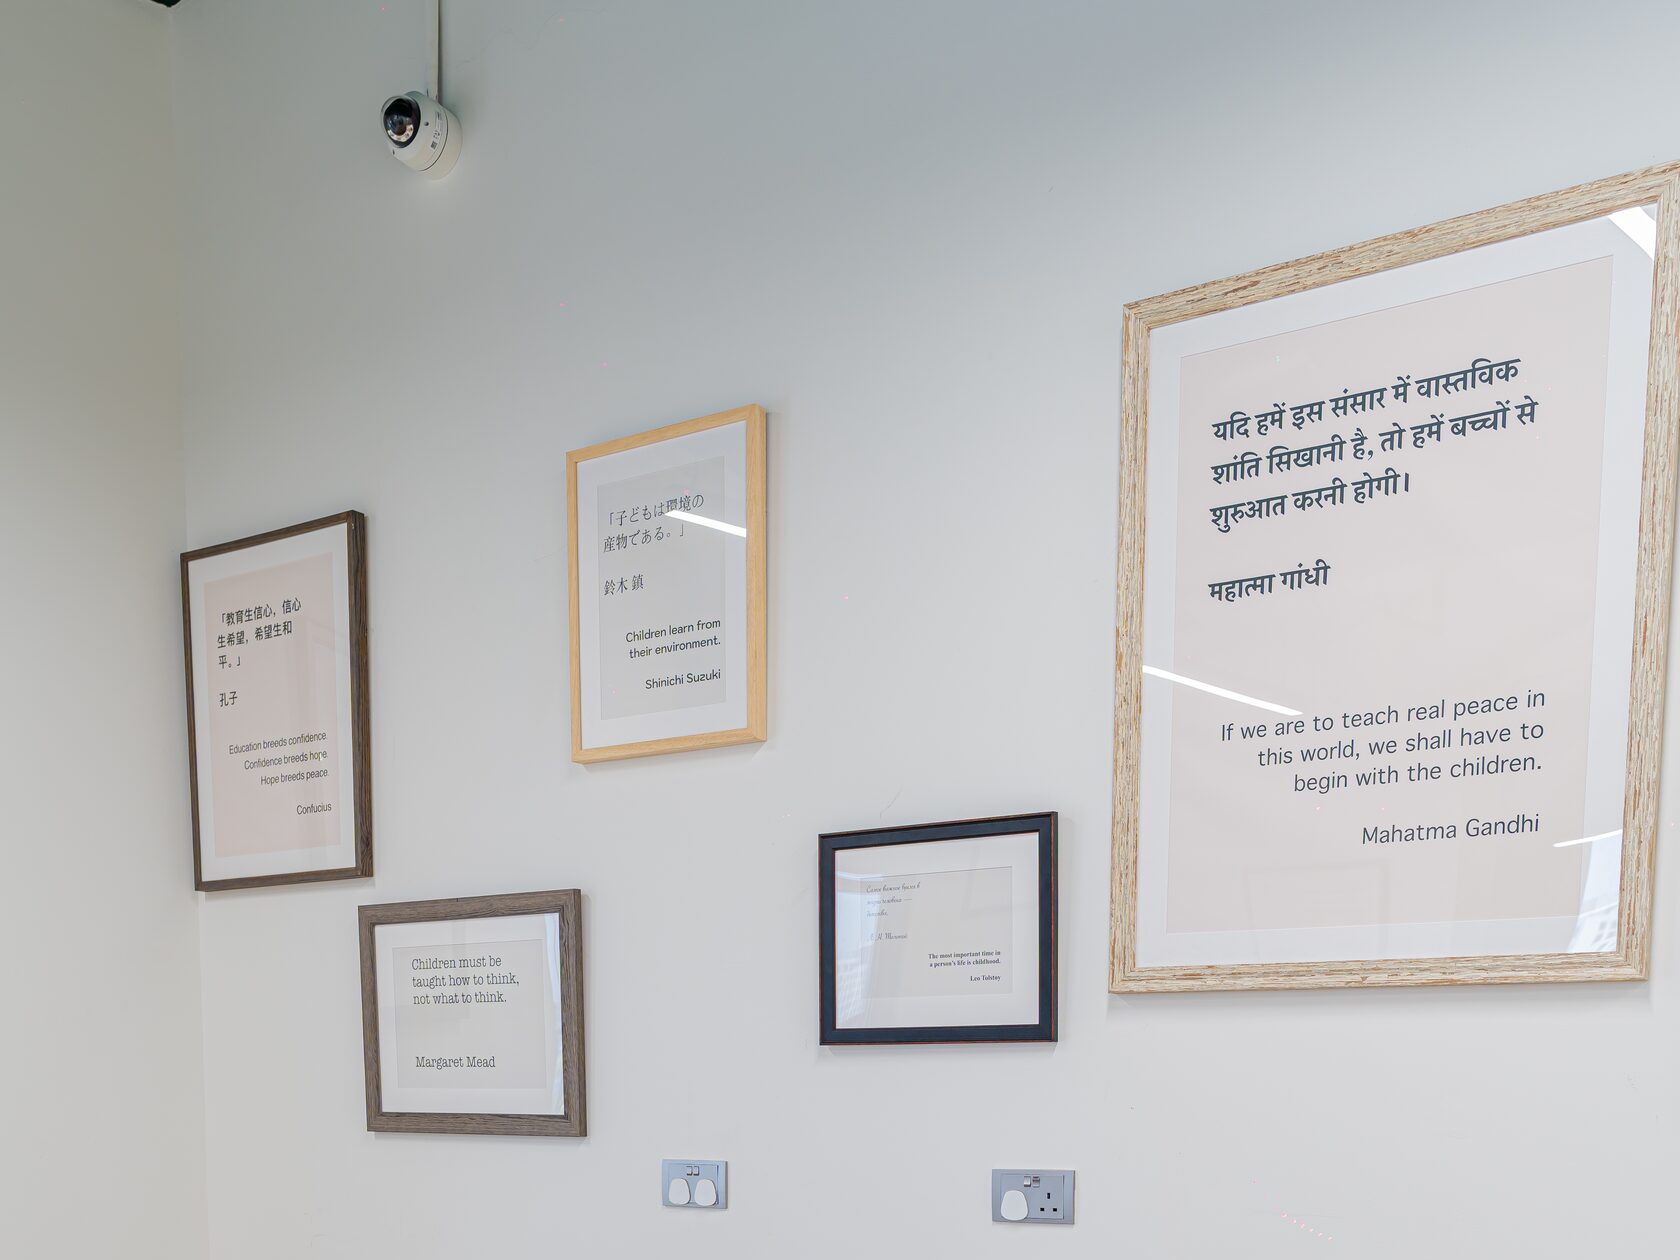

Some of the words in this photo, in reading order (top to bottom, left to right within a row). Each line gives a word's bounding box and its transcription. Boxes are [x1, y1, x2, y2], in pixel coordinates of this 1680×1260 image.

[1212, 411, 1251, 440] यदि
[1255, 402, 1286, 436] हमें
[1290, 401, 1326, 430] इस
[1329, 388, 1387, 417] संसार
[1391, 374, 1411, 403] में
[1415, 358, 1521, 399] वास्तविक
[1211, 451, 1263, 484] शांति
[1266, 434, 1347, 474] सिखानी
[1350, 427, 1374, 460] है,
[1378, 422, 1406, 452] तो
[1410, 413, 1445, 449] हमें
[1448, 399, 1511, 437] बच्चों
[1514, 395, 1539, 425] से
[1209, 495, 1288, 533] शुरुआत
[1292, 477, 1348, 511] करनी
[1351, 467, 1410, 503] होगी।
[1208, 574, 1276, 602] महात्मा
[1280, 558, 1331, 589] गांधी
[217, 620, 293, 650] 生希望，希望生和
[625, 628, 667, 643] Children
[668, 624, 694, 636] learn
[697, 619, 721, 631] from
[629, 646, 653, 659] their
[655, 635, 721, 655] environment.
[645, 675, 684, 690] Shinichi
[686, 668, 721, 684] Suzuki
[219, 690, 239, 708] 孔子
[1221, 723, 1234, 741] If
[1241, 724, 1267, 740] we
[1274, 720, 1305, 737] are
[1313, 715, 1334, 732] to
[1342, 705, 1399, 729] teach
[1407, 699, 1445, 722] real
[1453, 695, 1518, 721] peace
[1527, 690, 1545, 708] in
[228, 742, 261, 755] Education
[262, 737, 288, 750] breeds
[1258, 747, 1293, 766] this
[1300, 739, 1360, 762] world,
[1368, 740, 1397, 756] we
[1405, 729, 1451, 751] shall
[1460, 727, 1511, 747] have
[1520, 722, 1544, 739] to
[244, 756, 283, 770] Confidence
[283, 752, 309, 764] breeds
[260, 775, 280, 786] Hope
[280, 771, 305, 783] breeds
[1294, 771, 1348, 794] begin
[1356, 765, 1399, 787] with
[1407, 763, 1441, 782] the
[1450, 755, 1542, 778] children.
[296, 802, 332, 815] Confucius
[1362, 823, 1457, 844] Mahatma
[1465, 813, 1539, 837] Gandhi
[411, 957, 457, 971] Children
[459, 956, 487, 968] must
[489, 955, 502, 967] be
[953, 950, 981, 959] important
[412, 975, 446, 989] taught
[448, 975, 470, 986] how
[473, 973, 484, 985] to
[486, 972, 520, 987] think,
[981, 974, 1001, 982] Tolstoy
[413, 993, 431, 1005] not
[433, 992, 460, 1004] what
[461, 992, 473, 1004] to
[474, 991, 507, 1003] think.
[415, 1056, 464, 1070] Margaret
[466, 1056, 496, 1068] Mead
